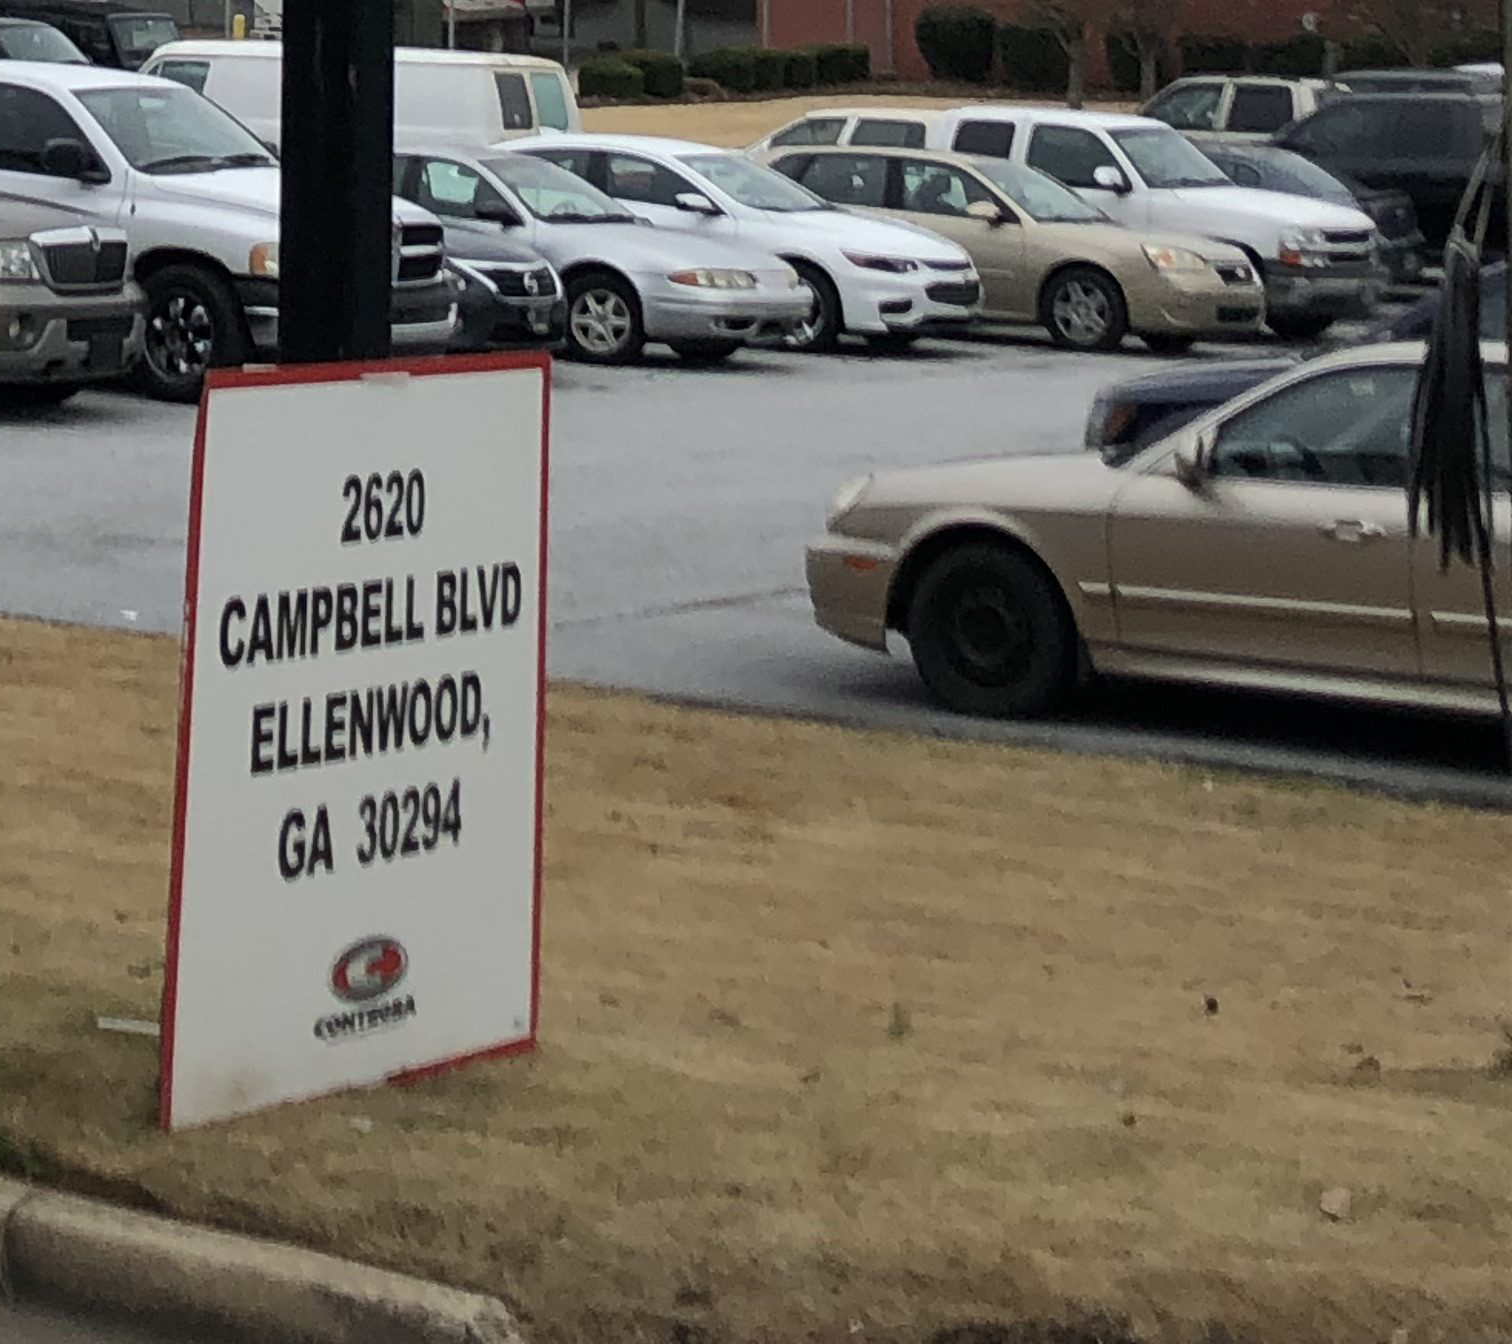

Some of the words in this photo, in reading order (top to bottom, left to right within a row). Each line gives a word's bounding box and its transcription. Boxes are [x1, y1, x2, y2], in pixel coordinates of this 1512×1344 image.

[340, 468, 426, 545] 2620
[219, 574, 425, 668] CAMPBELL
[435, 560, 523, 638] BLVD
[250, 669, 491, 777] ELLENWOOD,
[278, 803, 335, 883] GA
[356, 776, 462, 868] 30294
